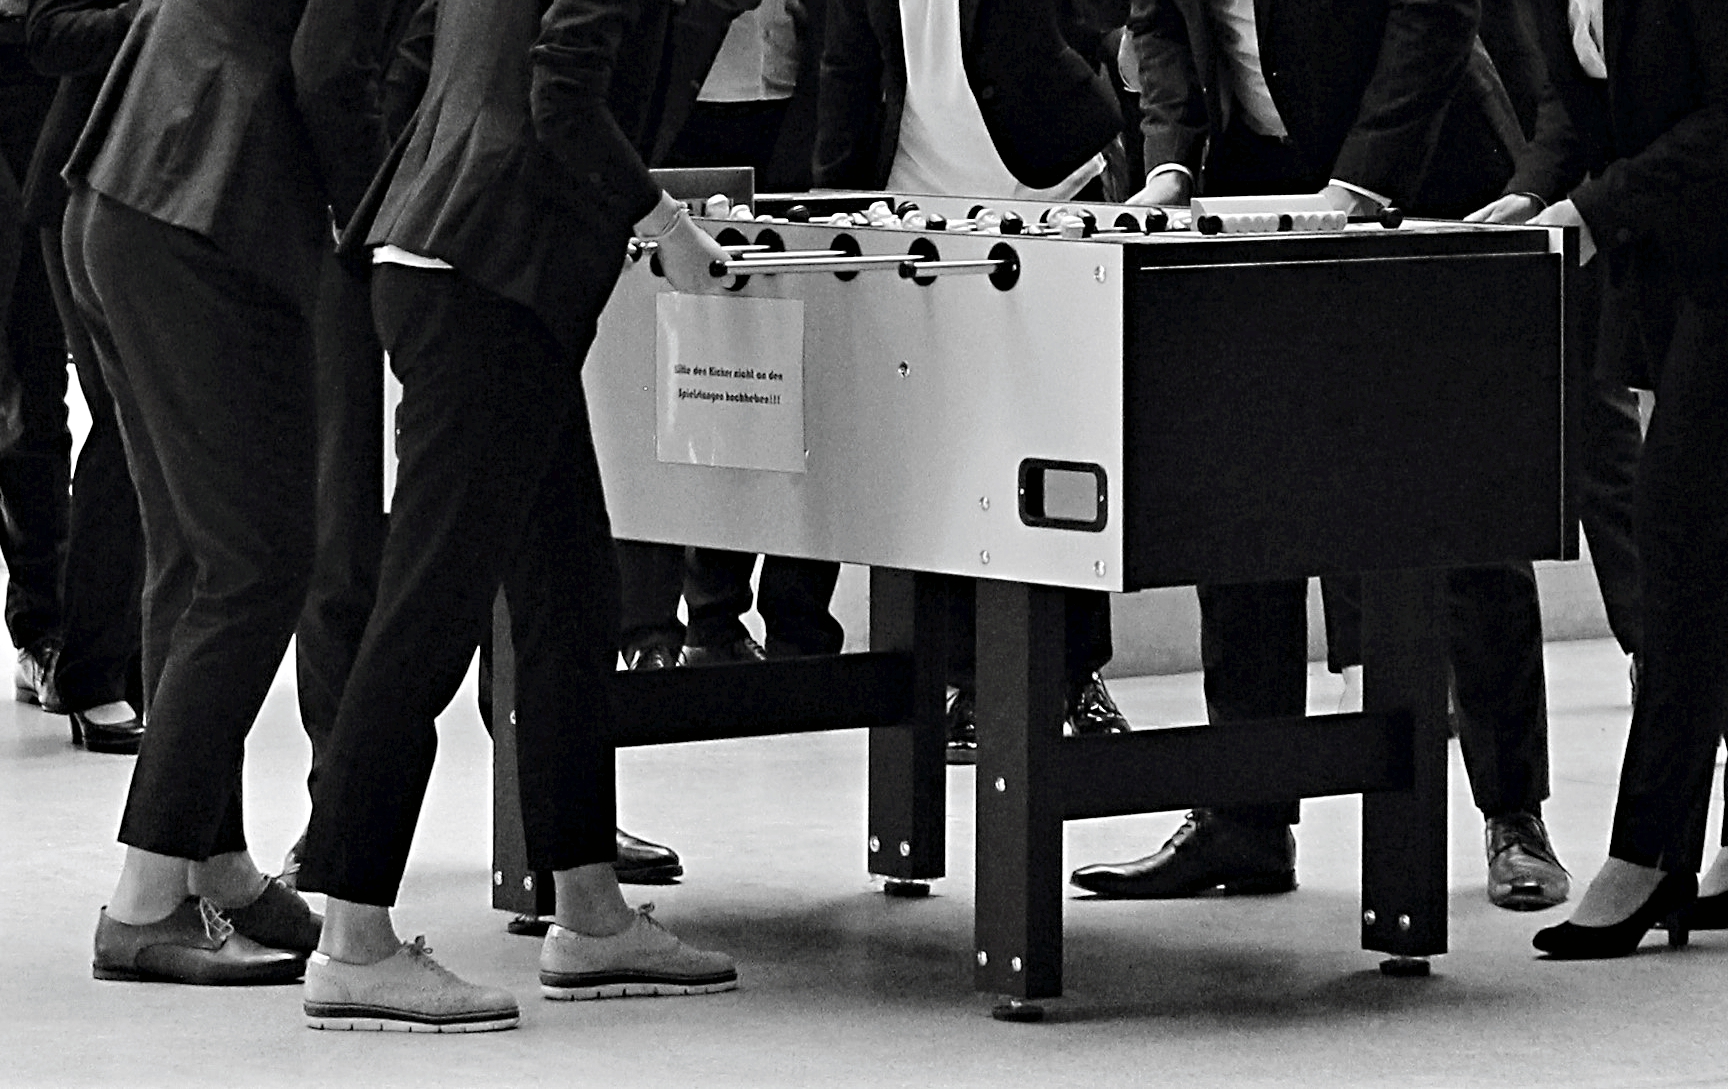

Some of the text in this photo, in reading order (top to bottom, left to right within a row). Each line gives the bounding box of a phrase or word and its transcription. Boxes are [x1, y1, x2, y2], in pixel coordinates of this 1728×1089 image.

[693, 364, 707, 376] den
[734, 368, 754, 379] nicht
[769, 370, 783, 381] den
